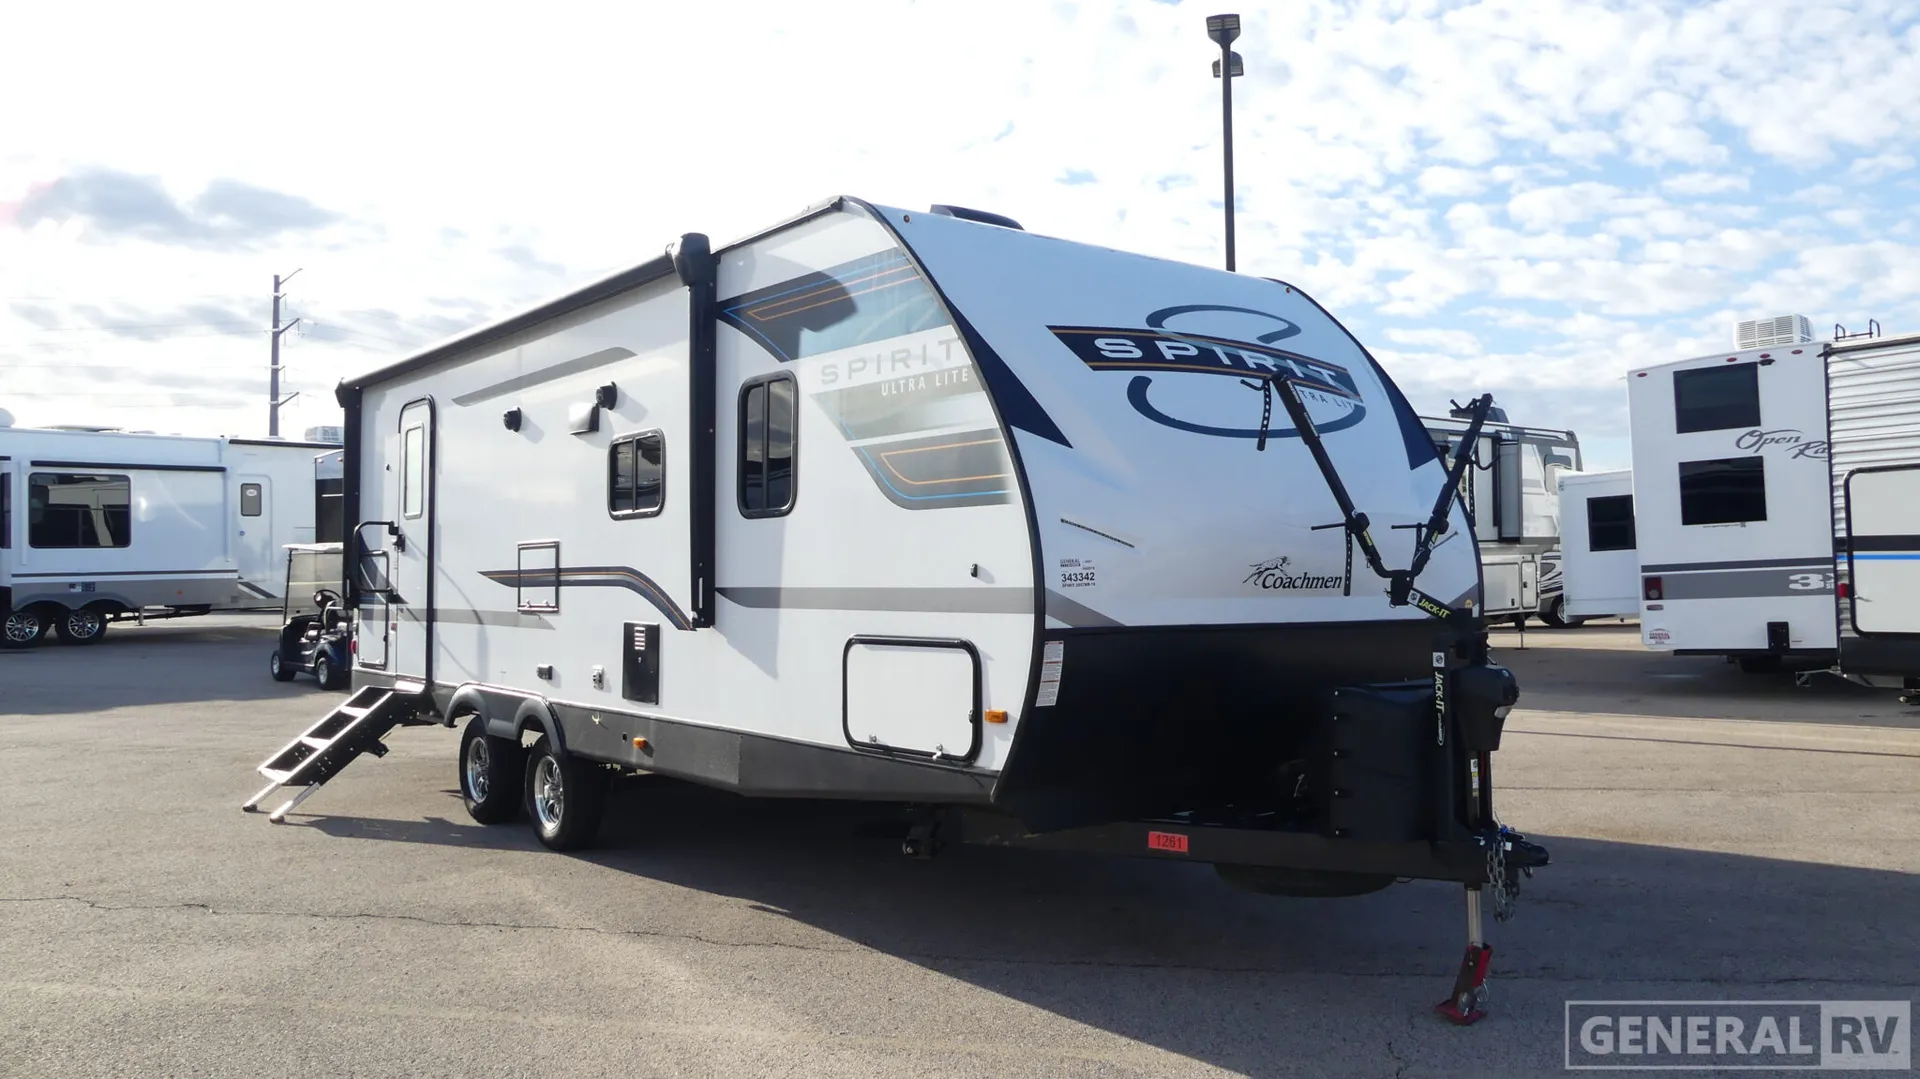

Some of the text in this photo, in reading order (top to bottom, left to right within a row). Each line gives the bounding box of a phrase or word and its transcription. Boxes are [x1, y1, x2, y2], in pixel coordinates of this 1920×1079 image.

[820, 339, 960, 386] SPIRIT
[1094, 338, 1338, 386] SPIRIT
[881, 367, 969, 396] ULTRA LITE
[1332, 397, 1354, 410] LIT
[1735, 429, 1804, 453] Open
[1061, 572, 1095, 582] 343342
[1261, 572, 1342, 590] Coachmen
[1418, 598, 1451, 619] JACK-IT
[1435, 671, 1445, 714] JACK-IT
